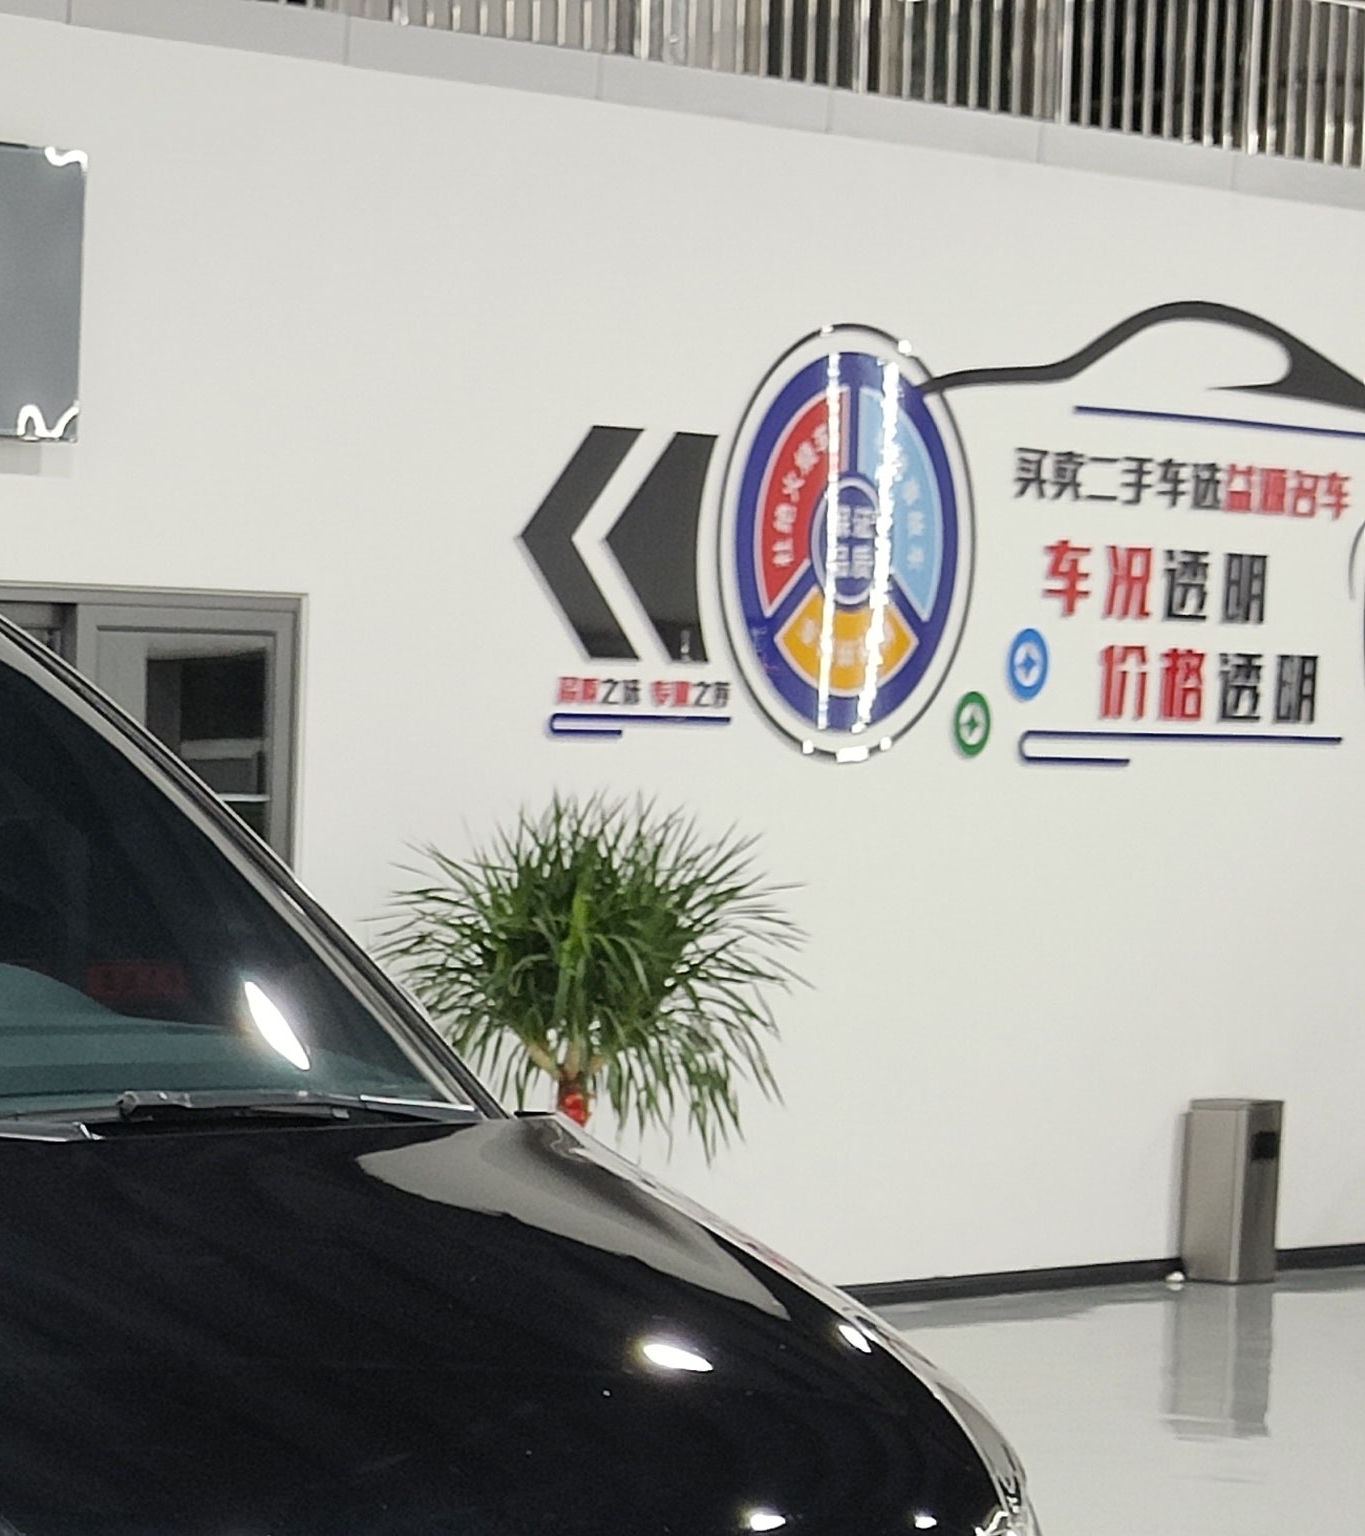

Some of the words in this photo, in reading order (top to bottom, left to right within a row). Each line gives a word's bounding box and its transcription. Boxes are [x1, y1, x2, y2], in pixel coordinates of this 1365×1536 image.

[1043, 539, 1269, 625] 车况透明
[1099, 644, 1320, 724] 价格透明
